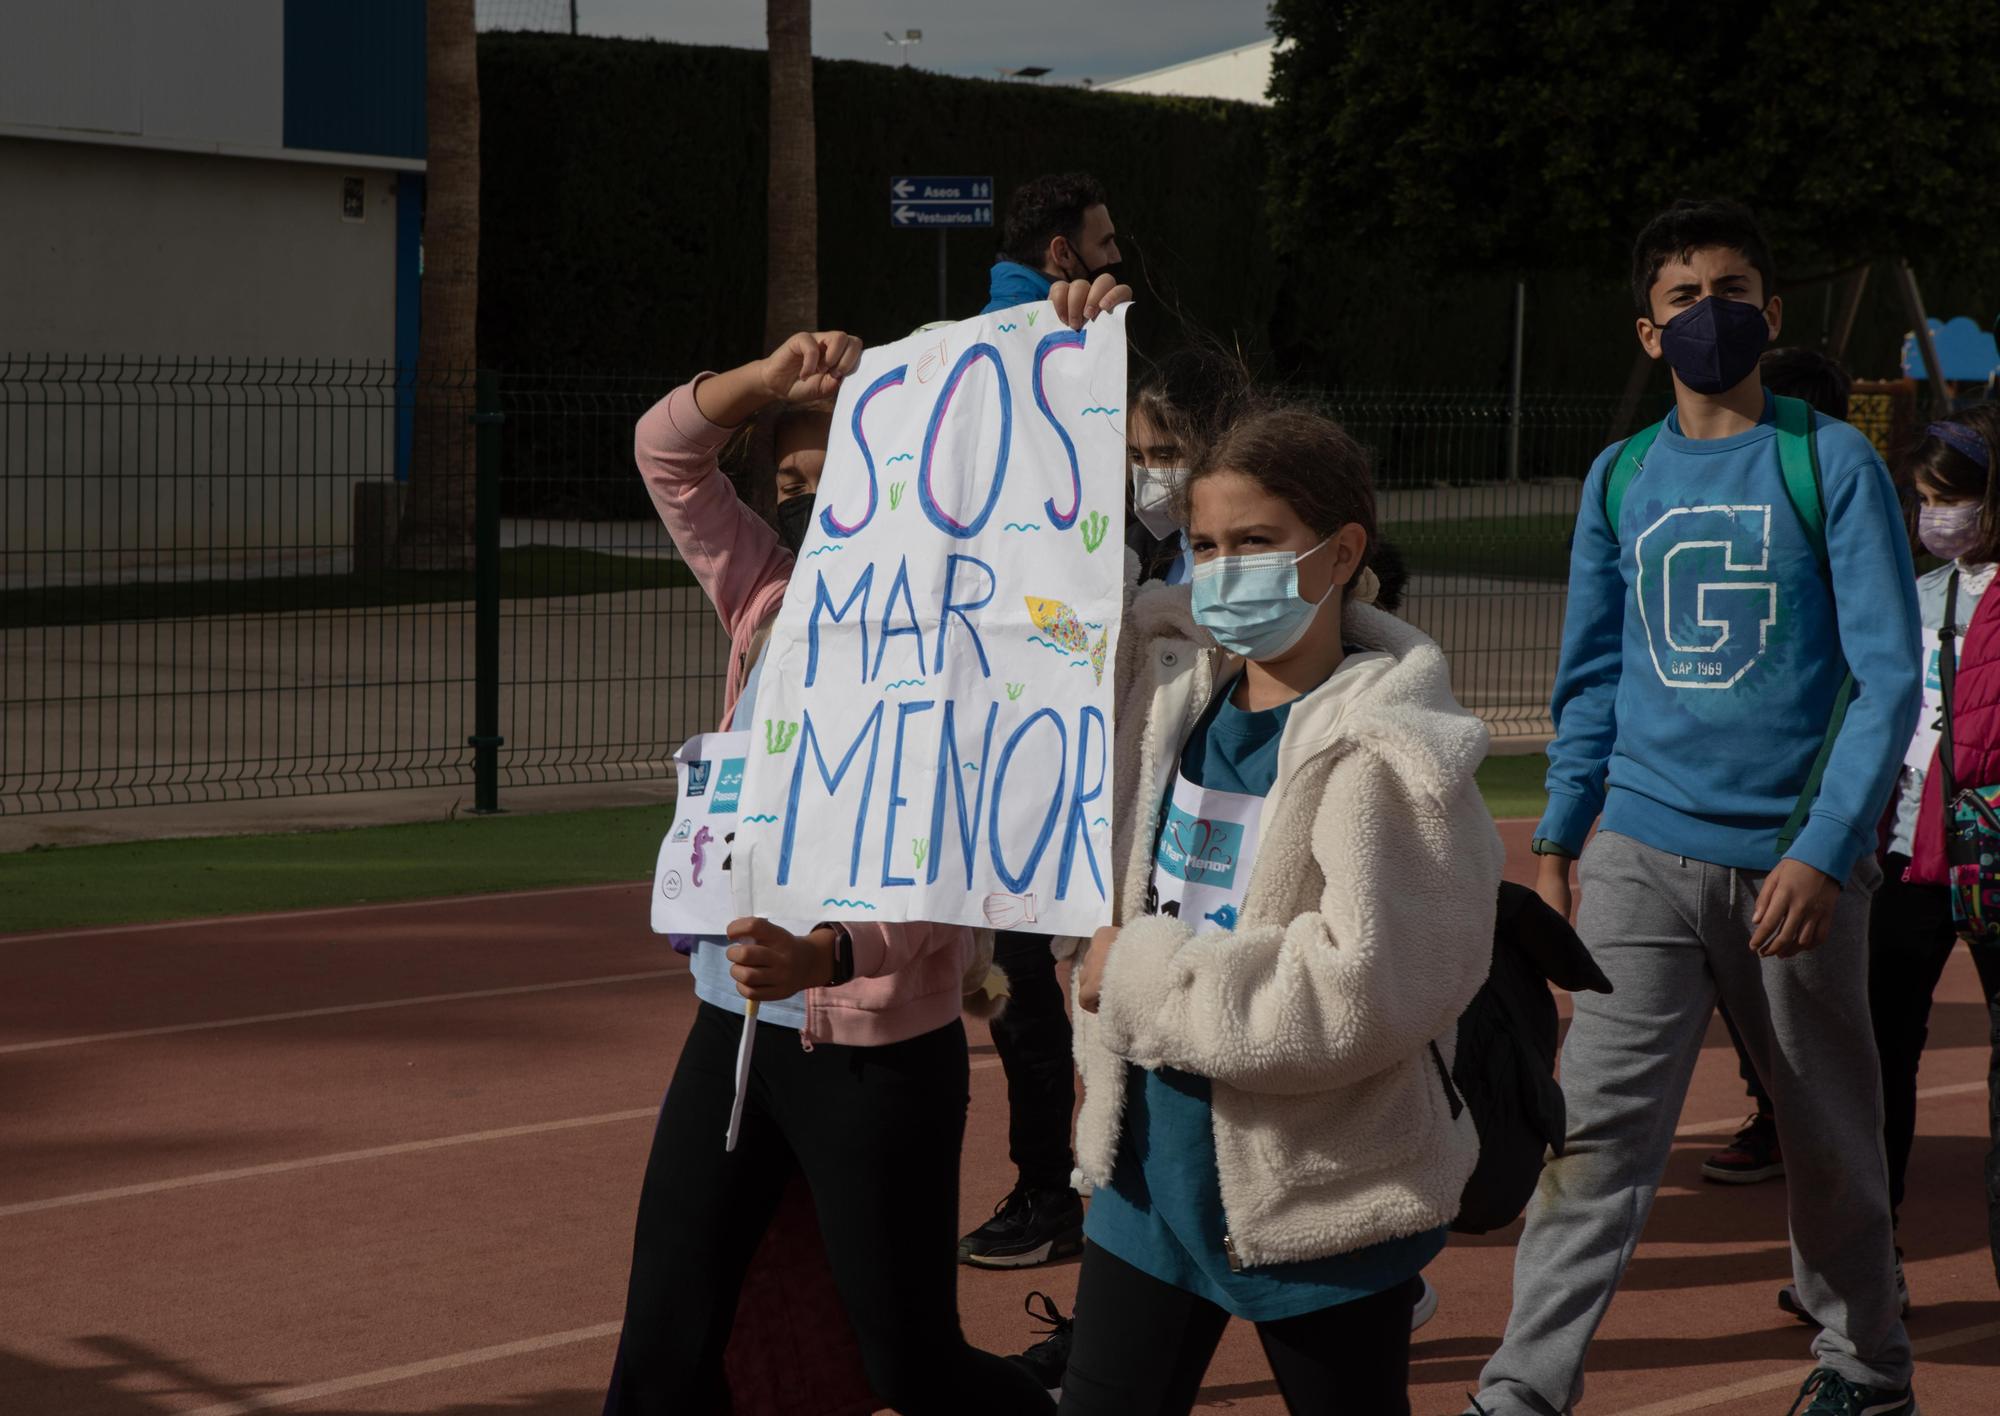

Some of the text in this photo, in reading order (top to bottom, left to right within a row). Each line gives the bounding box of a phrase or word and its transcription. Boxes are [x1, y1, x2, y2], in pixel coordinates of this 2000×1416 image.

[916, 212, 973, 223] Vestuarios
[924, 186, 961, 198] Aseos
[819, 328, 1088, 539] SOS
[804, 553, 997, 688] MAR
[1635, 504, 1777, 689] G
[1672, 661, 1723, 676] GAP 1969
[776, 699, 1107, 904] MENOR
[1185, 853, 1232, 873] Menor
